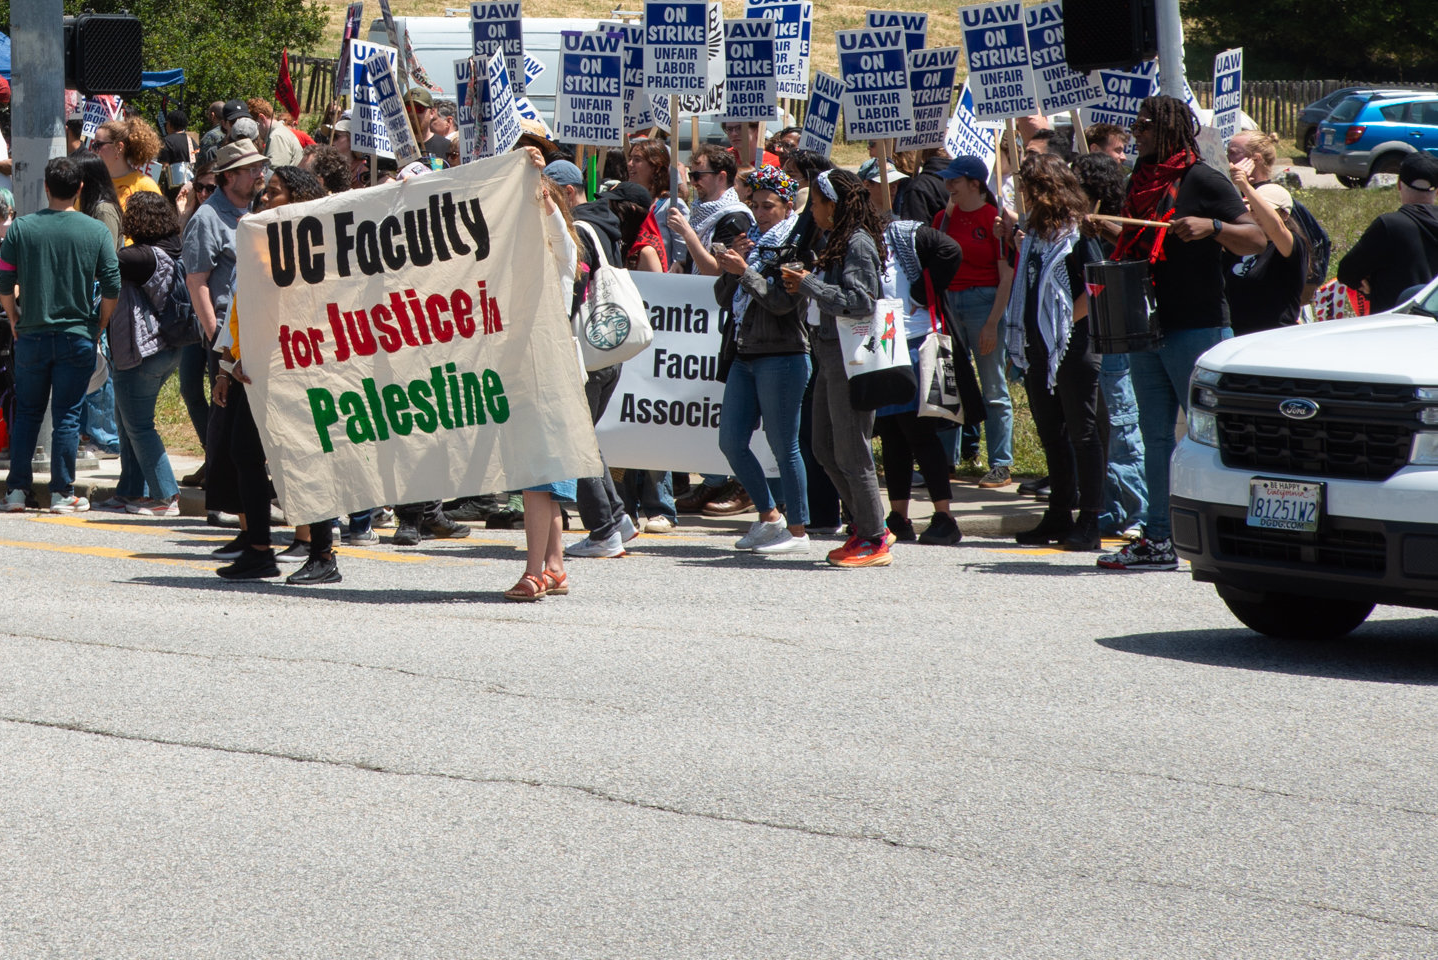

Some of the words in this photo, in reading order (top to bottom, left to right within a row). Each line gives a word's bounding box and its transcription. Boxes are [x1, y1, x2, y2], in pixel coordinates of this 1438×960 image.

[473, 4, 519, 19] UAW
[664, 7, 686, 23] ON
[963, 4, 1020, 27] UAW
[488, 24, 506, 38] ON
[870, 14, 925, 31] UAW
[648, 25, 704, 42] STRIKE
[839, 31, 901, 50] UAW
[984, 29, 1007, 47] ON
[564, 35, 621, 52] UAW
[731, 43, 753, 58] ON
[654, 47, 697, 60] UNFAIR
[860, 54, 884, 70] ON
[913, 50, 958, 68] UAW
[971, 47, 1026, 68] STRIKE
[367, 56, 388, 77] UAW
[489, 51, 502, 79] AW
[580, 58, 601, 74] ON
[657, 62, 695, 74] LABOR
[726, 60, 772, 75] TRIKE
[1217, 52, 1241, 73] UAW
[565, 75, 619, 93] STRIKE
[647, 76, 704, 88] PRACTICE
[846, 71, 905, 89] STRIKE
[923, 72, 941, 87] ON
[980, 69, 1023, 86] UNFAIR
[1048, 76, 1089, 94] LABOR
[1107, 77, 1131, 93] ON
[1222, 75, 1233, 91] ON
[491, 78, 502, 99] ON
[815, 74, 844, 99] UAW
[985, 84, 1023, 100] LABOR
[571, 98, 612, 111] UNFAIR
[854, 92, 900, 106] UNFAIR
[978, 97, 1035, 115] PRACTICE
[1043, 86, 1102, 110] PRACTICE
[1215, 91, 1240, 110] STRIKE
[818, 99, 830, 117] ON
[858, 106, 899, 120] LABOR
[572, 112, 610, 125] LABOR
[807, 114, 834, 139] STRIKE
[850, 119, 911, 134] PRACTICE
[915, 120, 938, 132] ABOR
[1217, 112, 1235, 127] UNFAIR
[496, 116, 515, 142] LABOR
[564, 125, 619, 140] PRACTICE
[496, 122, 521, 155] PRACTICE
[806, 135, 826, 155] UNFAIR
[900, 132, 944, 146] PRACTICE
[958, 123, 988, 158] UNFAIR
[266, 215, 326, 288] UC
[334, 192, 491, 278] Faculty
[278, 324, 324, 370] for
[327, 289, 476, 362] Justice
[478, 280, 503, 335] in
[653, 348, 718, 381] Facu
[307, 362, 510, 453] Palestine
[620, 393, 722, 428] Associa
[1287, 403, 1307, 414] Ford
[1267, 488, 1308, 499] California
[1255, 498, 1316, 522] 81251W2
[1260, 519, 1304, 529] DGDG.COM
